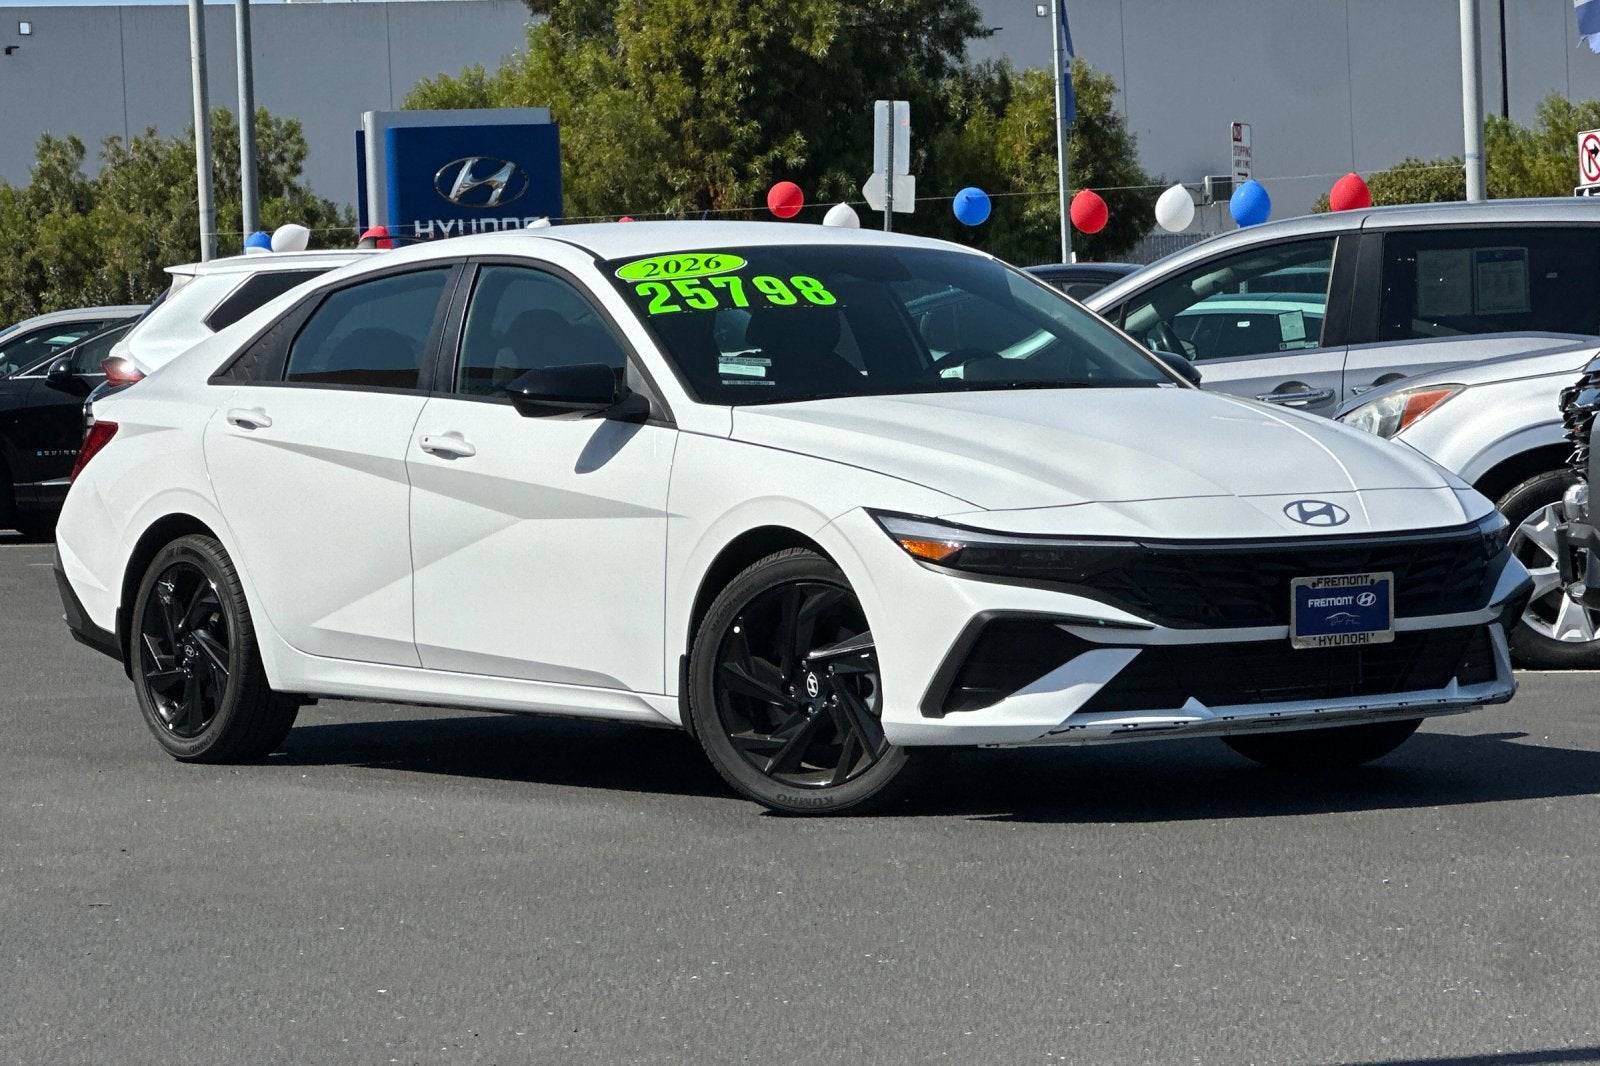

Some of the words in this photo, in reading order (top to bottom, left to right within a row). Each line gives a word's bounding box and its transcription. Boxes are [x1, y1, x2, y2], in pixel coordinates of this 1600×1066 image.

[642, 255, 722, 278] 2026
[635, 276, 837, 314] 25798
[1316, 575, 1370, 587] FREMONT
[1308, 596, 1354, 608] FREMONT
[1319, 633, 1369, 646] HYUNDAI
[776, 793, 833, 806] KUMHO
